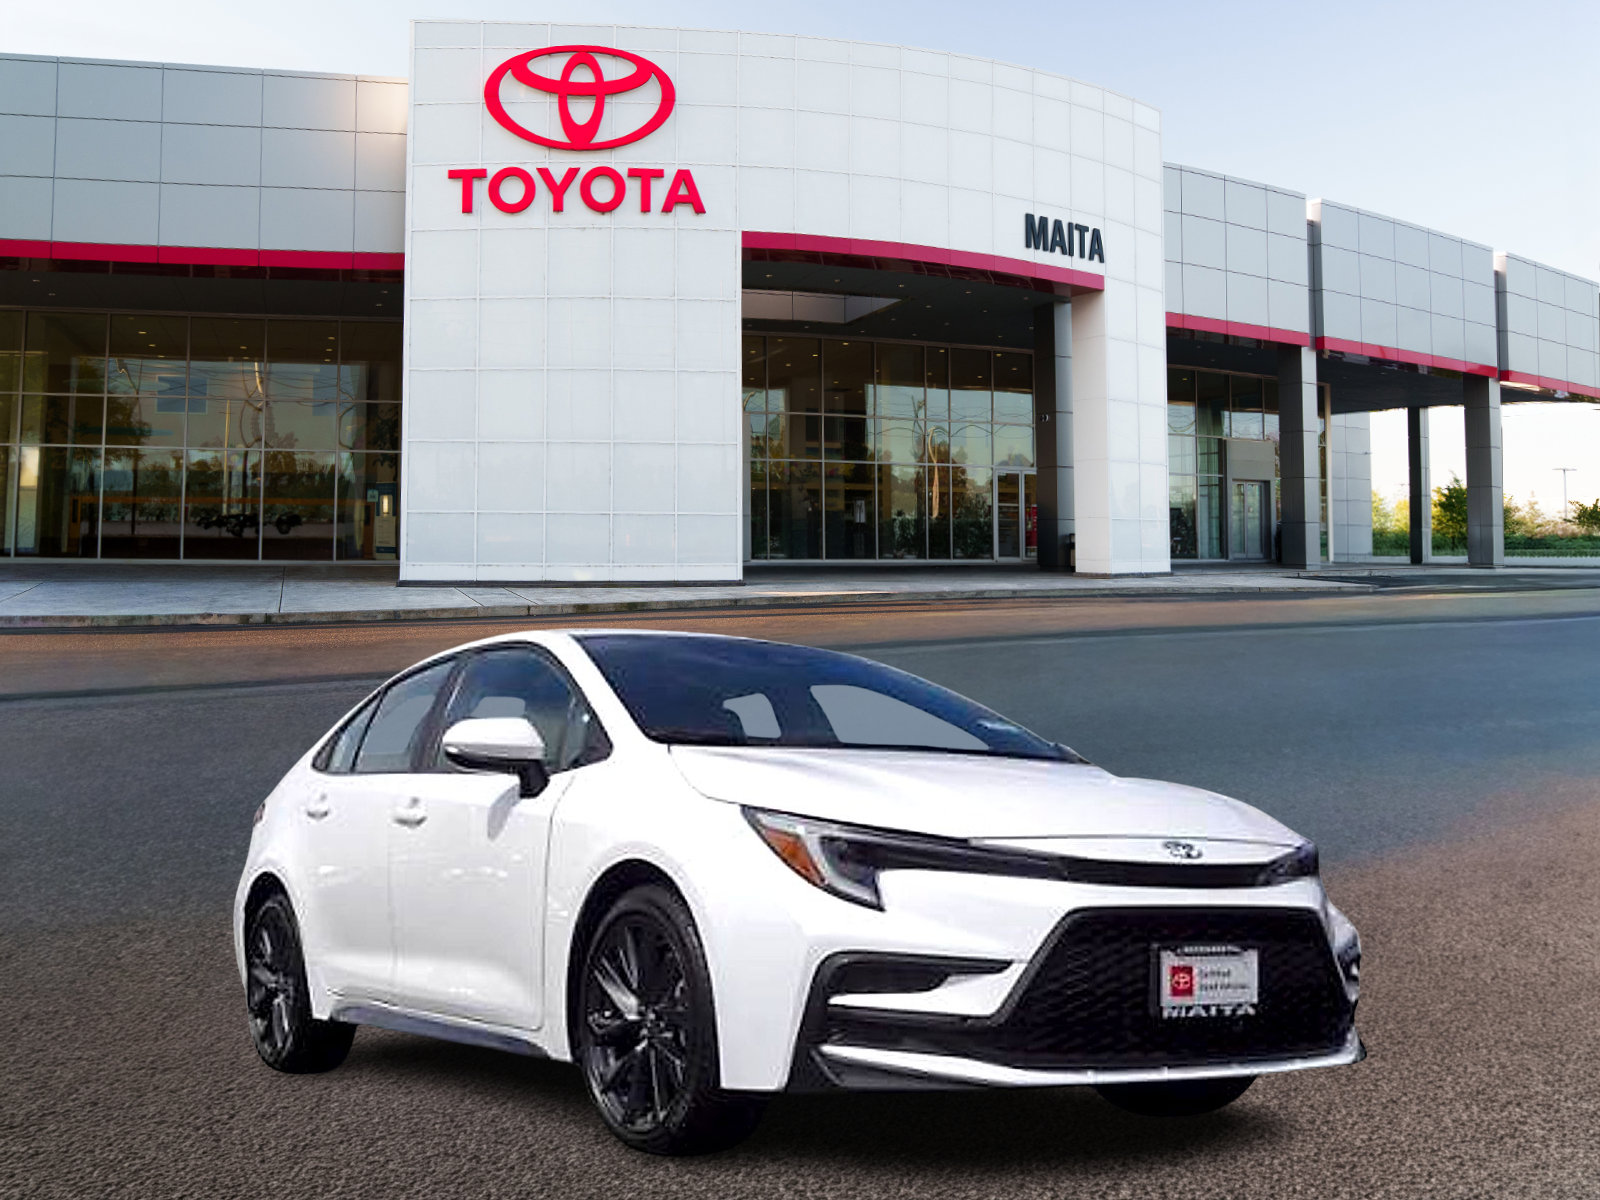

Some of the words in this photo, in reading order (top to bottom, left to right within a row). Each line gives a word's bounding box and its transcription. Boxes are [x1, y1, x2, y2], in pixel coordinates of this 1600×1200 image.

[448, 166, 706, 213] TOYOTA
[1025, 213, 1104, 263] MAITA
[1163, 1005, 1256, 1019] MAITA
